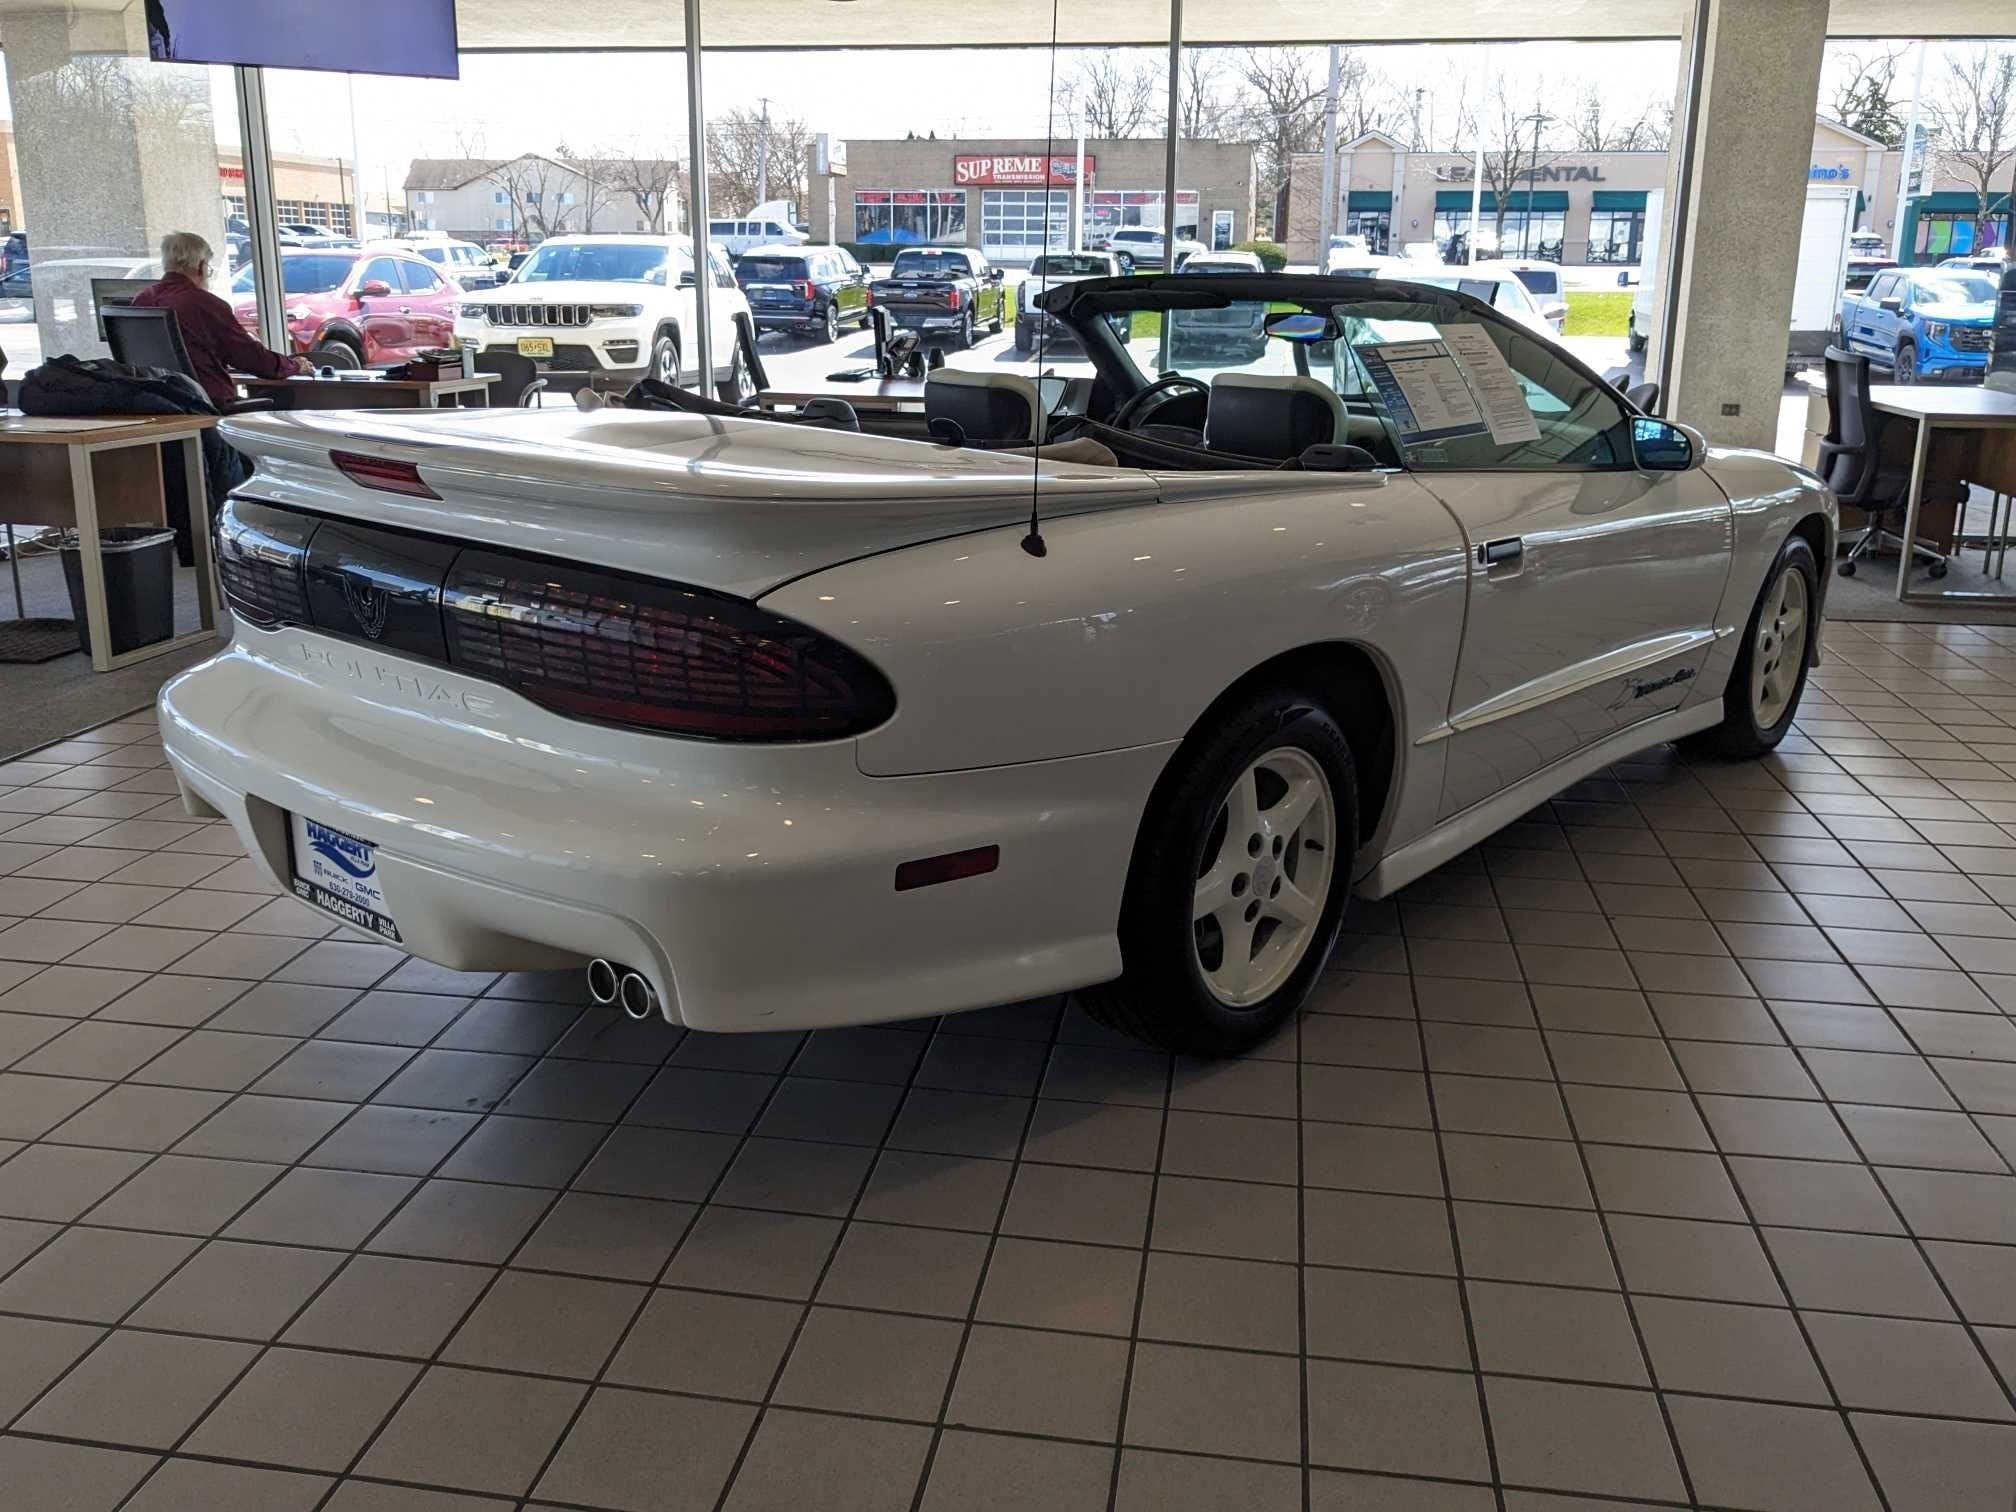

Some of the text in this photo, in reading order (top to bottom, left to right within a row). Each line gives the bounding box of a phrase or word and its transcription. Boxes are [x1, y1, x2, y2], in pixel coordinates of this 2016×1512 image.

[956, 157, 1042, 182] SUPREME
[300, 643, 499, 719] PONTIAC
[306, 821, 374, 862] HAGGERT
[316, 889, 374, 928] HAGGERTY
[355, 882, 381, 901] GMC
